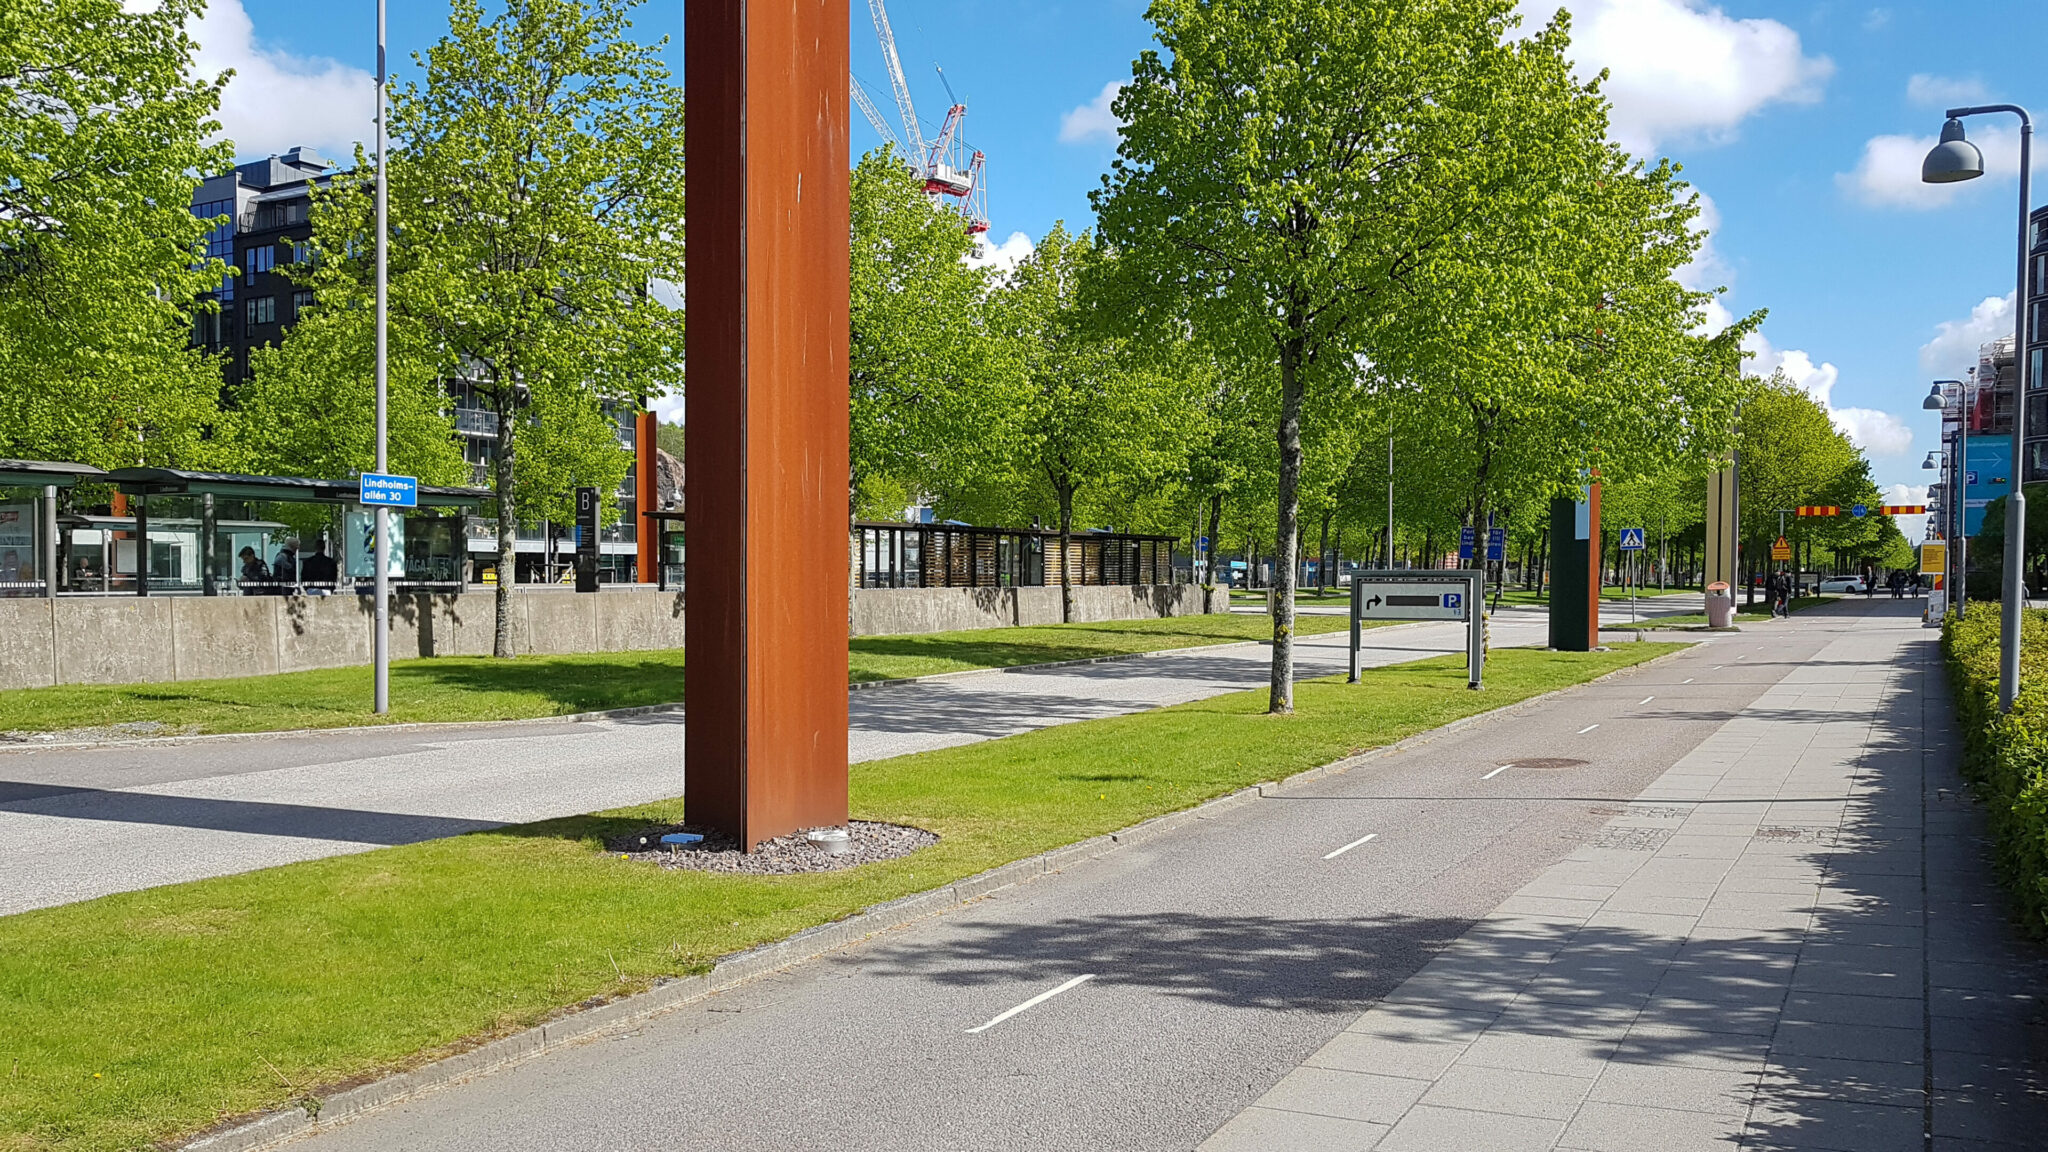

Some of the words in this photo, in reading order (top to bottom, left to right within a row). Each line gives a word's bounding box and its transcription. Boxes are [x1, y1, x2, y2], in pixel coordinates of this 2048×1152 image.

[364, 478, 414, 490] Lindholms-
[364, 490, 387, 501] allén
[389, 491, 402, 501] 30
[581, 492, 590, 510] B
[1448, 595, 1457, 607] P
